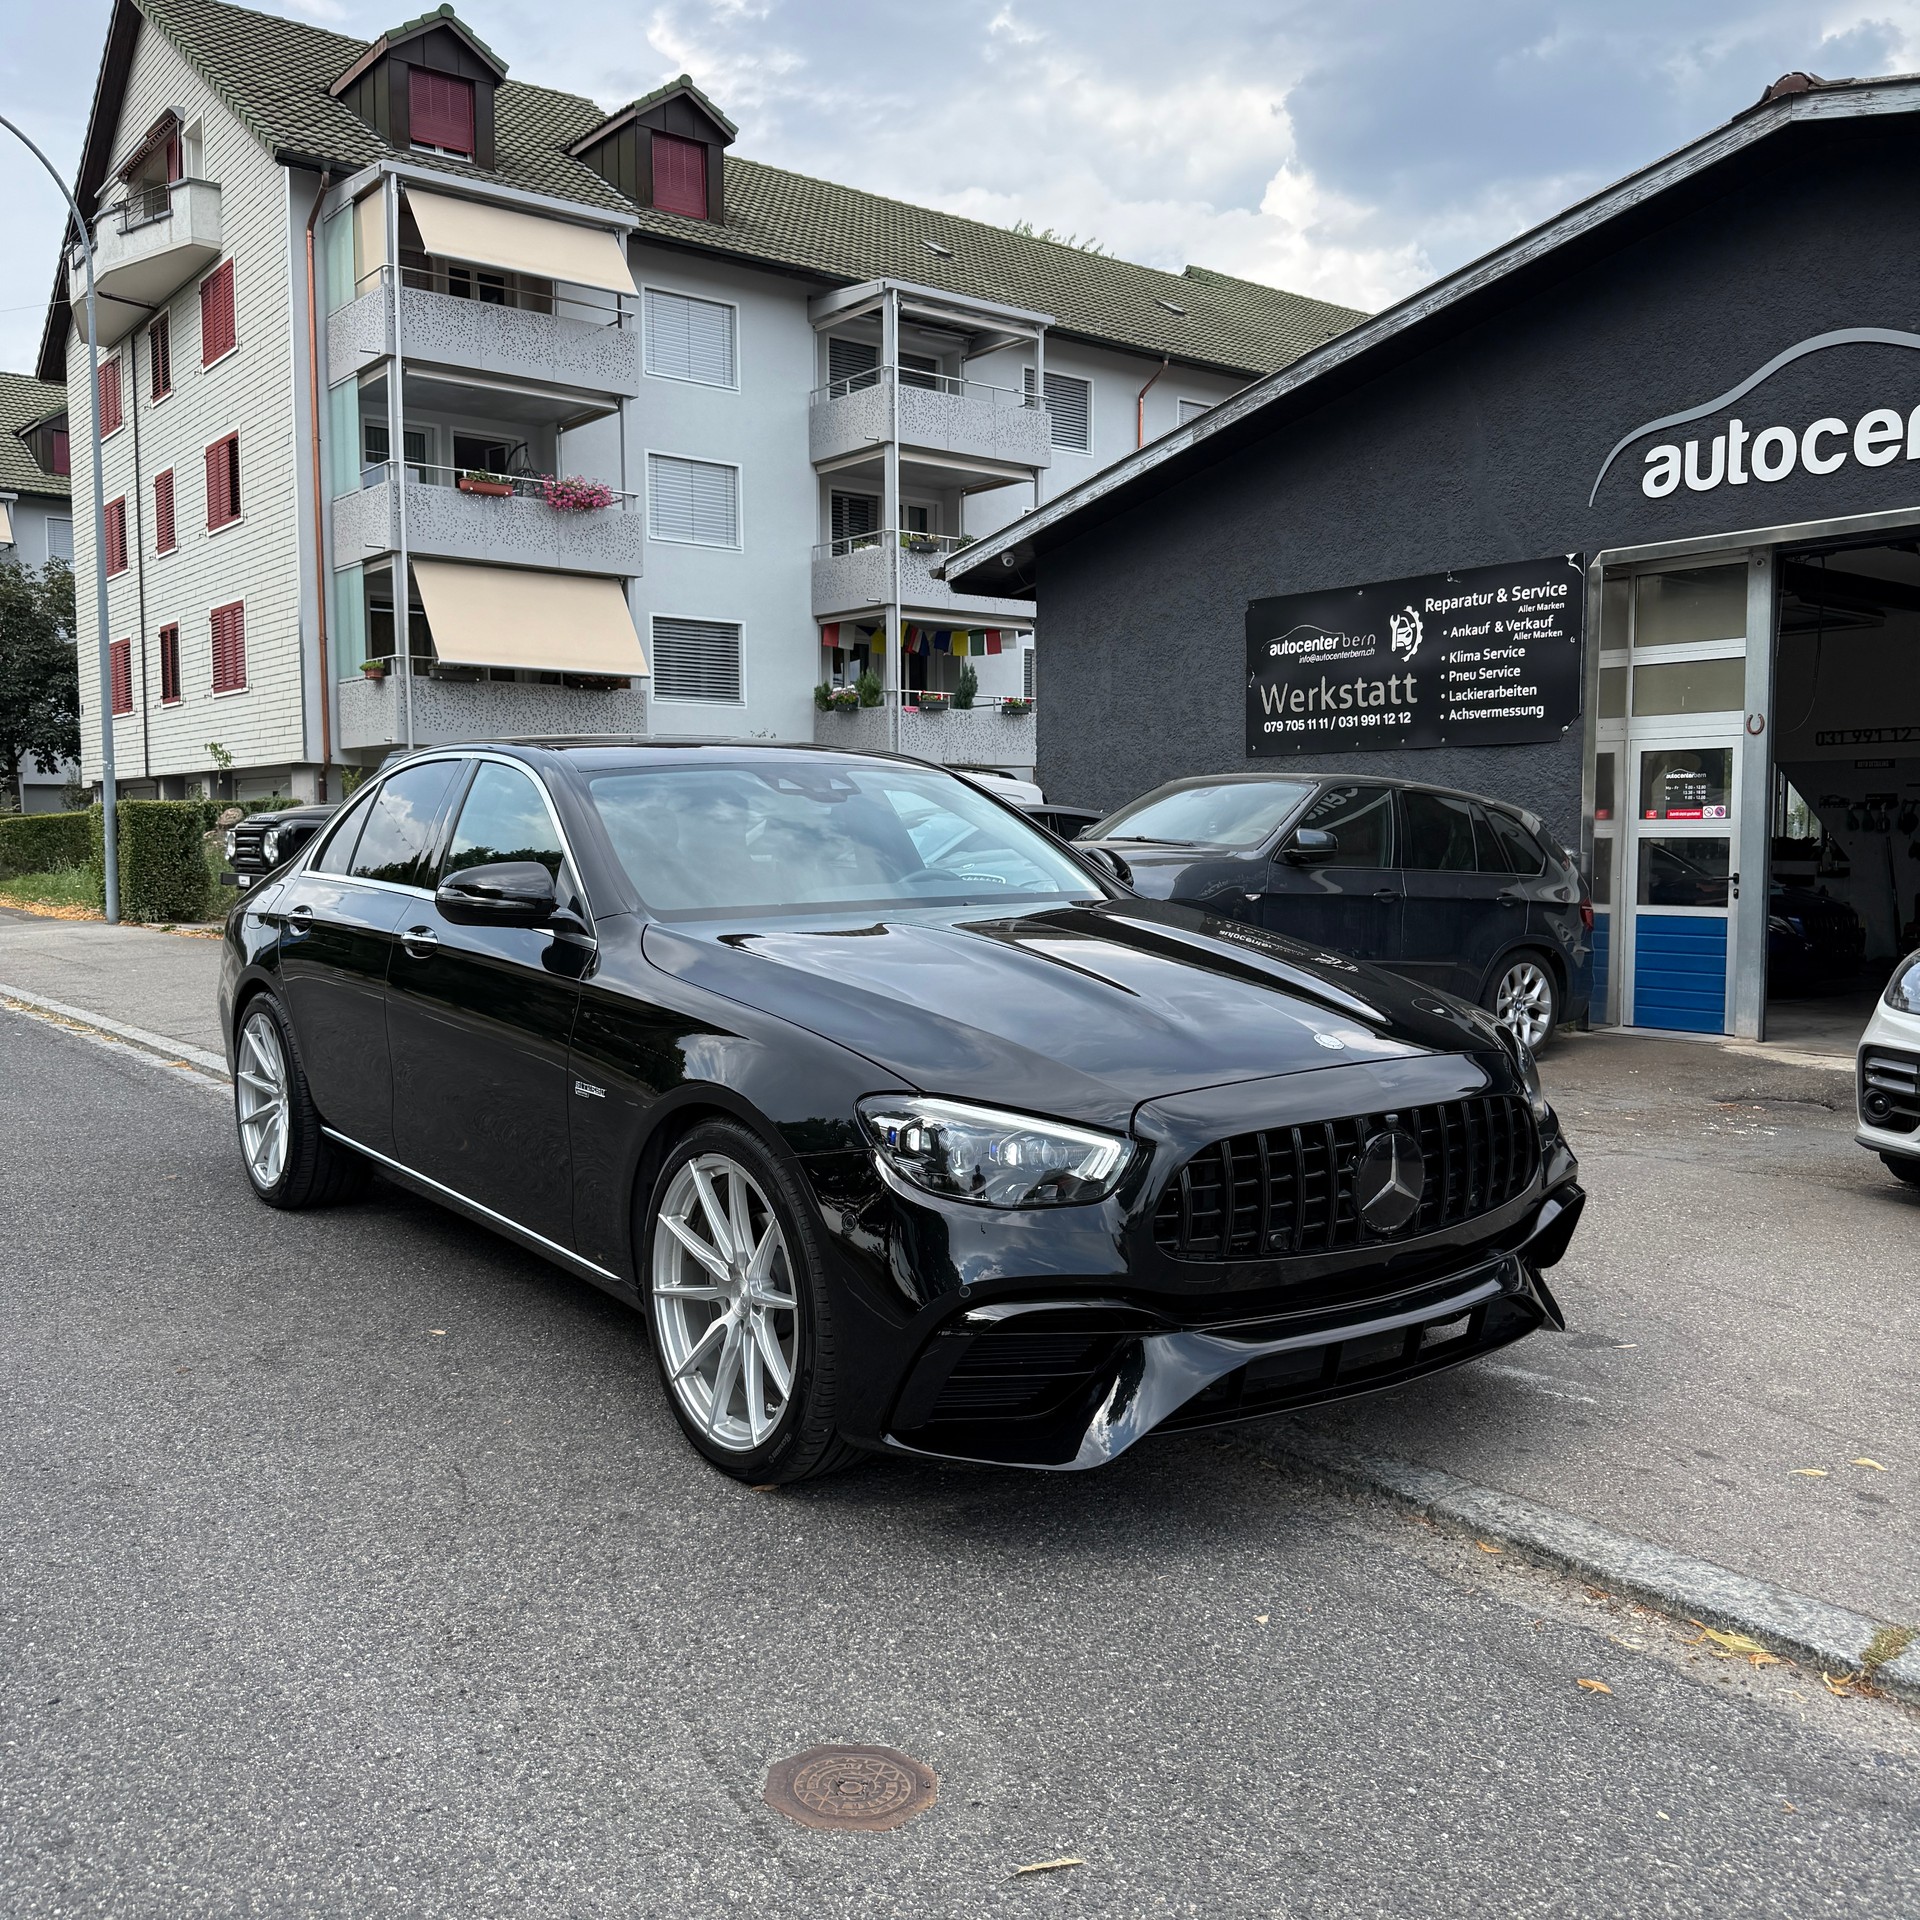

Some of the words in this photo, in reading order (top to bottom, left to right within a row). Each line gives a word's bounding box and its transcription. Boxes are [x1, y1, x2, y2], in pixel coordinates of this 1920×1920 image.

[1425, 592, 1494, 615] Reparatur
[1496, 587, 1508, 603] &
[1511, 581, 1568, 601] Service
[1518, 603, 1536, 613] Aller
[1536, 601, 1565, 612] Marken
[1450, 621, 1491, 638] Ankauf
[1494, 620, 1504, 633] &
[1506, 614, 1554, 632] Verkauf
[1513, 631, 1531, 641] Aller
[1532, 628, 1563, 639] Marken
[1269, 635, 1340, 656] autocenter
[1342, 632, 1376, 648] bern
[1298, 647, 1376, 664] info@autocenterbern.ch
[1449, 650, 1481, 664] Klima
[1483, 645, 1526, 660] Service
[1449, 670, 1477, 682] Pneu
[1478, 665, 1521, 680] Service
[1260, 672, 1418, 715] Werkstatt
[1449, 684, 1537, 702] Lackierarbeiten
[1263, 720, 1284, 733] 079
[1285, 719, 1305, 732] 705
[1307, 717, 1317, 730] 11
[1318, 716, 1329, 730] 11
[1338, 714, 1359, 728] 031
[1360, 713, 1381, 726] 991
[1382, 712, 1396, 725] 12
[1399, 711, 1412, 724] 12
[1448, 705, 1544, 721] Achsvermessung
